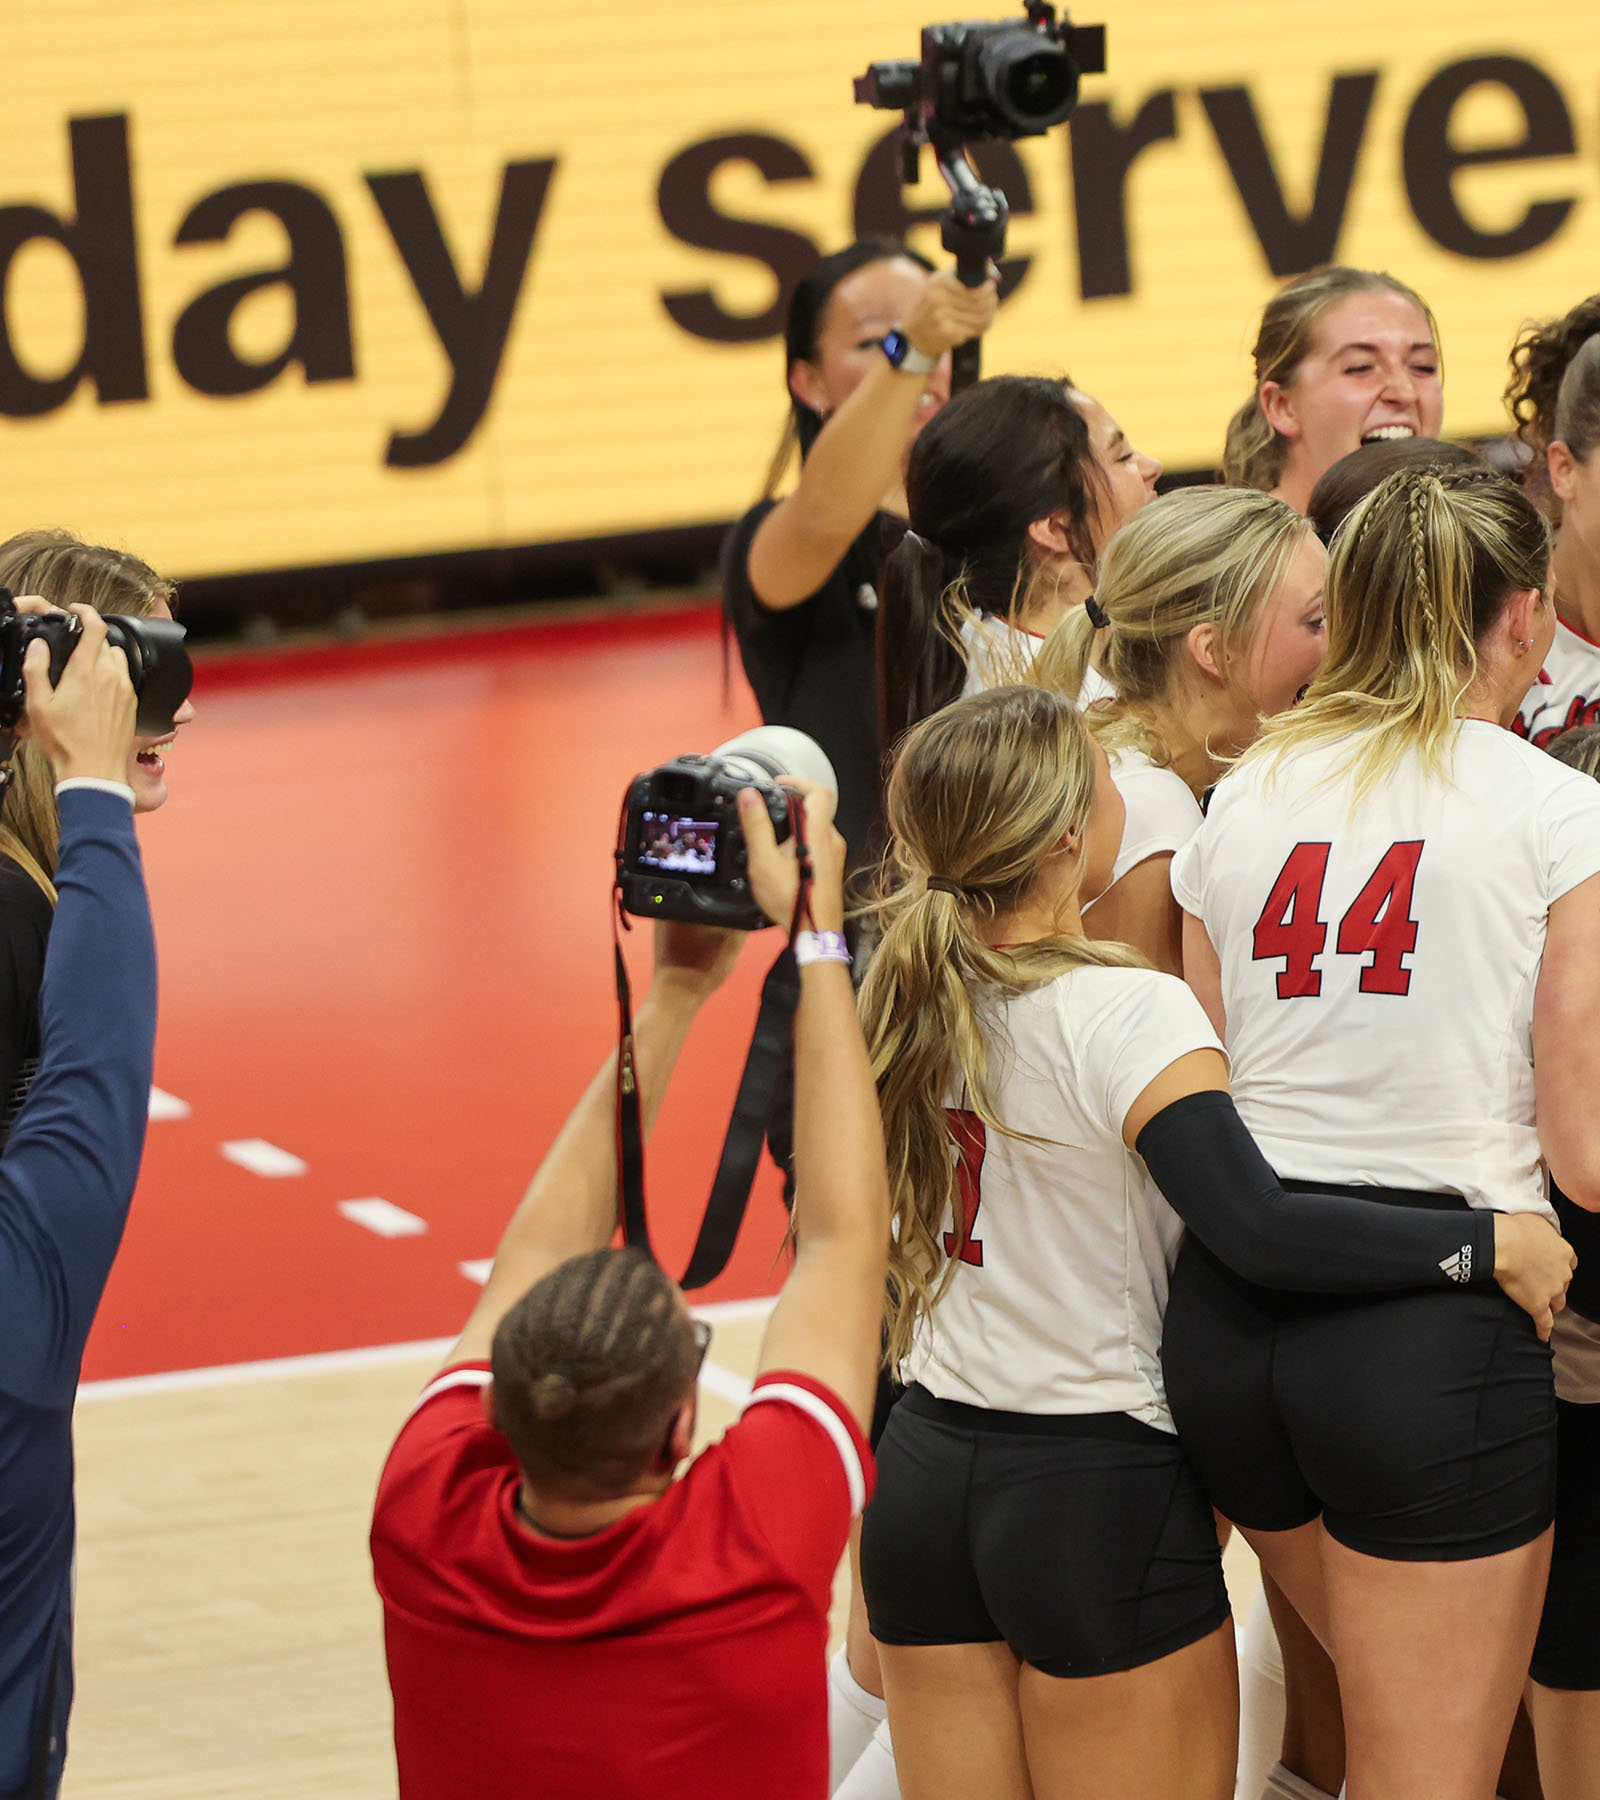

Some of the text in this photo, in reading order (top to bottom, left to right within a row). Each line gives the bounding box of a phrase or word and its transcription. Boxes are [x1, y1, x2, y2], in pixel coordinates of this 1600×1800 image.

[0, 112, 562, 470] day
[1252, 839, 1425, 1000] 44
[1459, 1244, 1473, 1283] adidas
